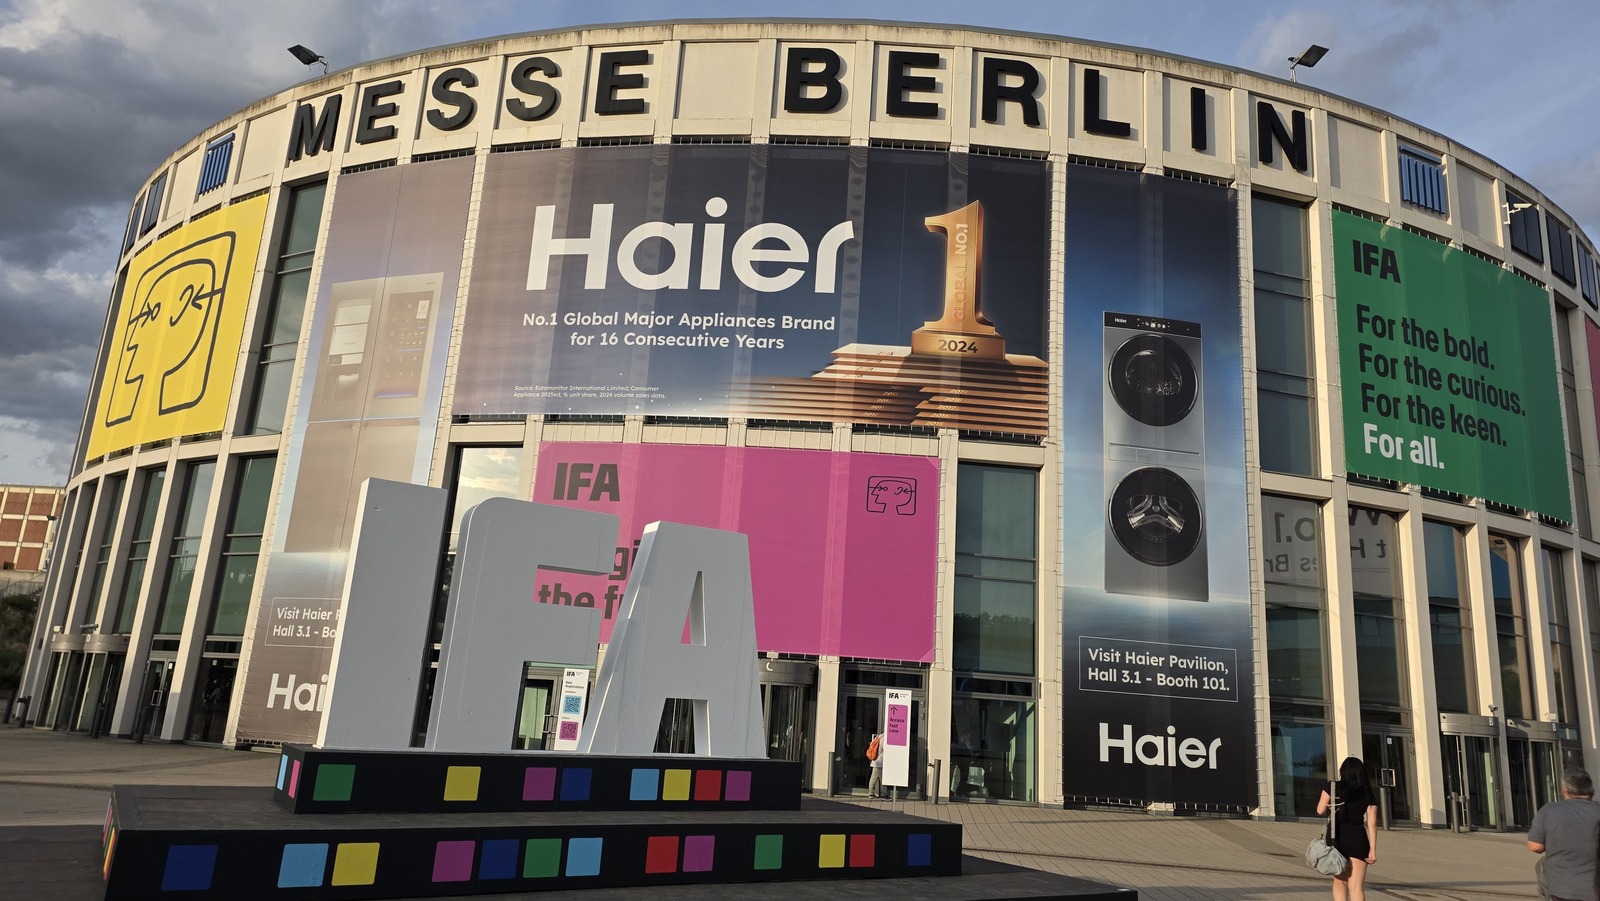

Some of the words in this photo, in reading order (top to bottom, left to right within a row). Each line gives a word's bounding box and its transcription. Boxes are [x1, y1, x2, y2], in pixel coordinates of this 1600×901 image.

[288, 49, 649, 161] MESSE
[784, 47, 1307, 171] BERLIN
[526, 197, 855, 293] Haier
[955, 223, 969, 256] NO.1
[1352, 239, 1401, 284] IFA
[953, 261, 967, 322] GLOBAL
[522, 313, 558, 327] No.1
[563, 312, 618, 327] Global
[624, 312, 674, 329] Major
[678, 313, 776, 330] Appliances
[781, 315, 836, 331] Brand
[570, 332, 595, 346] for
[599, 332, 619, 346] 16
[623, 332, 730, 348] Consecutive
[735, 334, 785, 350] Years
[1356, 303, 1396, 341] For
[1401, 317, 1440, 352] the
[1443, 328, 1495, 371] bold.
[937, 339, 978, 354] 2024
[1358, 343, 1398, 380] For
[1404, 356, 1442, 391] the
[1447, 372, 1526, 416] curious.
[1361, 382, 1401, 419] For
[1407, 394, 1445, 430] the
[1449, 403, 1507, 447] keen.
[1363, 422, 1403, 460] For
[1409, 435, 1445, 469] all.
[553, 462, 621, 501] IFA
[272, 625, 295, 637] Hall
[296, 625, 311, 637] 3.1
[277, 606, 300, 619] Visit
[302, 608, 332, 620] Haier
[311, 477, 769, 761] IFA
[1088, 648, 1121, 663] Visit
[1125, 651, 1165, 667] Haier
[1169, 655, 1229, 674] Pavilion,
[1088, 667, 1117, 682] Hall
[1121, 670, 1142, 684] 3.1
[1156, 673, 1198, 689] Booth
[1202, 677, 1230, 691] 101.
[1099, 722, 1222, 769] Haier
